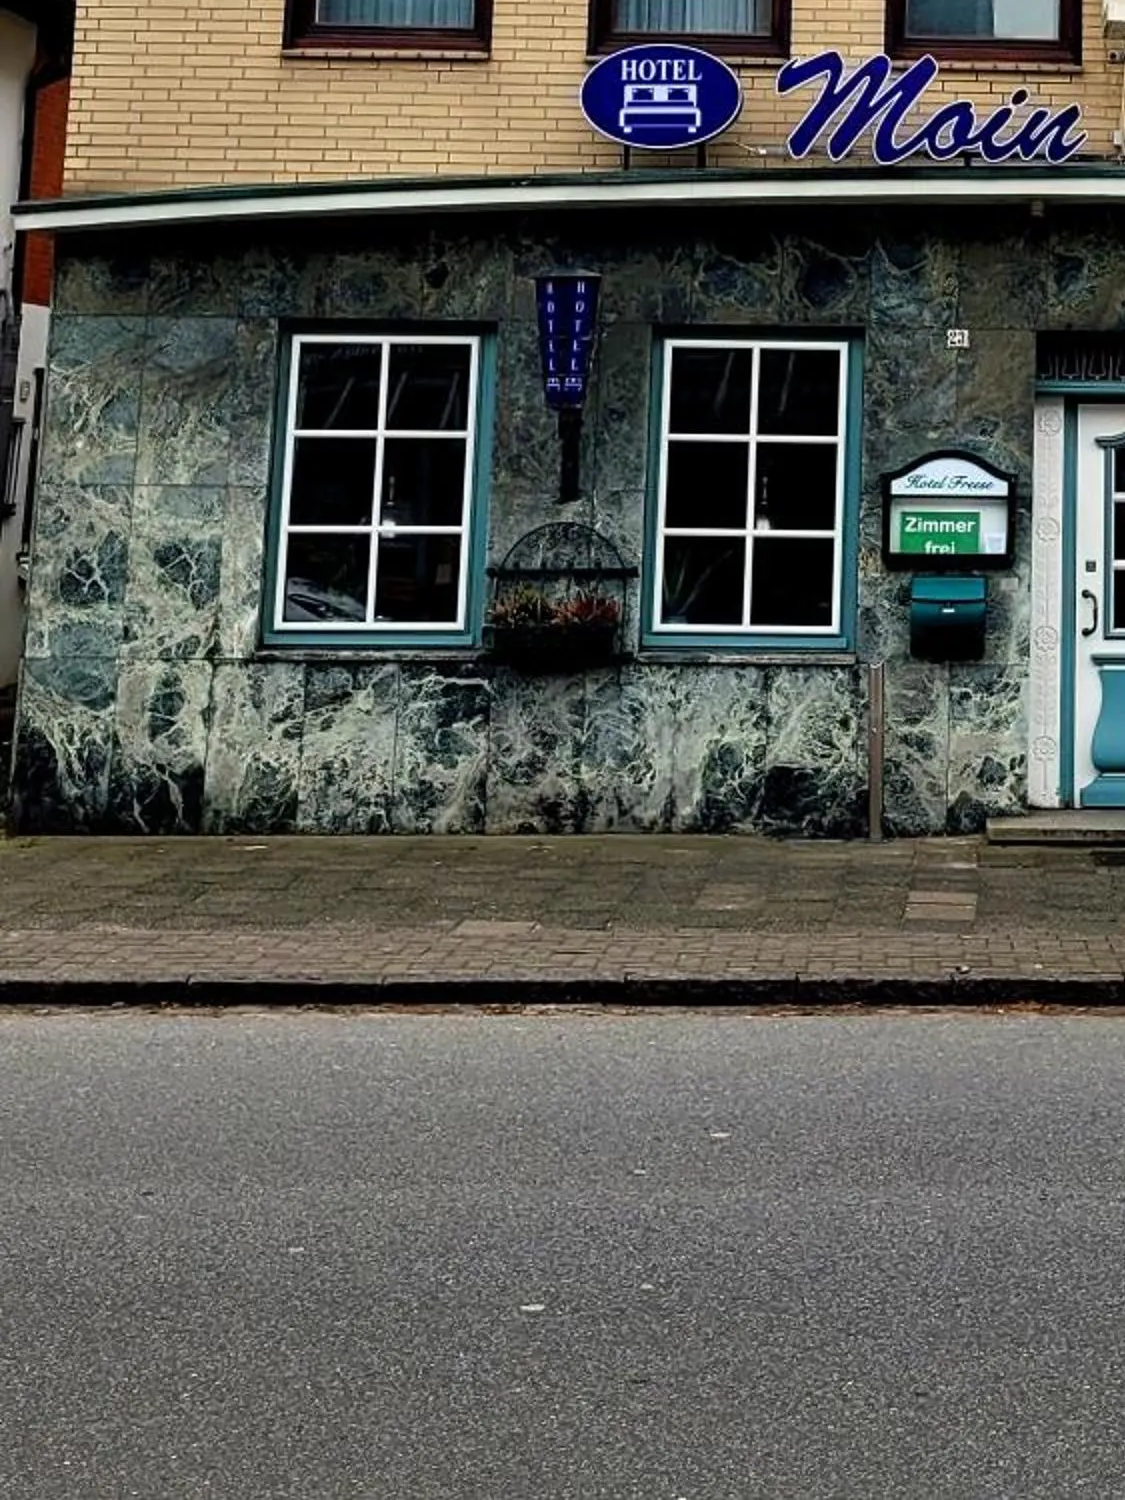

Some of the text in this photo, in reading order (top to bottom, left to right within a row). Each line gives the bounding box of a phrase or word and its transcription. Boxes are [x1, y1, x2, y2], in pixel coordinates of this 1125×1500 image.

[620, 58, 703, 82] HOTEL
[776, 50, 1089, 165] Moin
[905, 474, 945, 489] Hotel
[904, 516, 977, 533] Zimmer
[924, 540, 956, 555] frei
